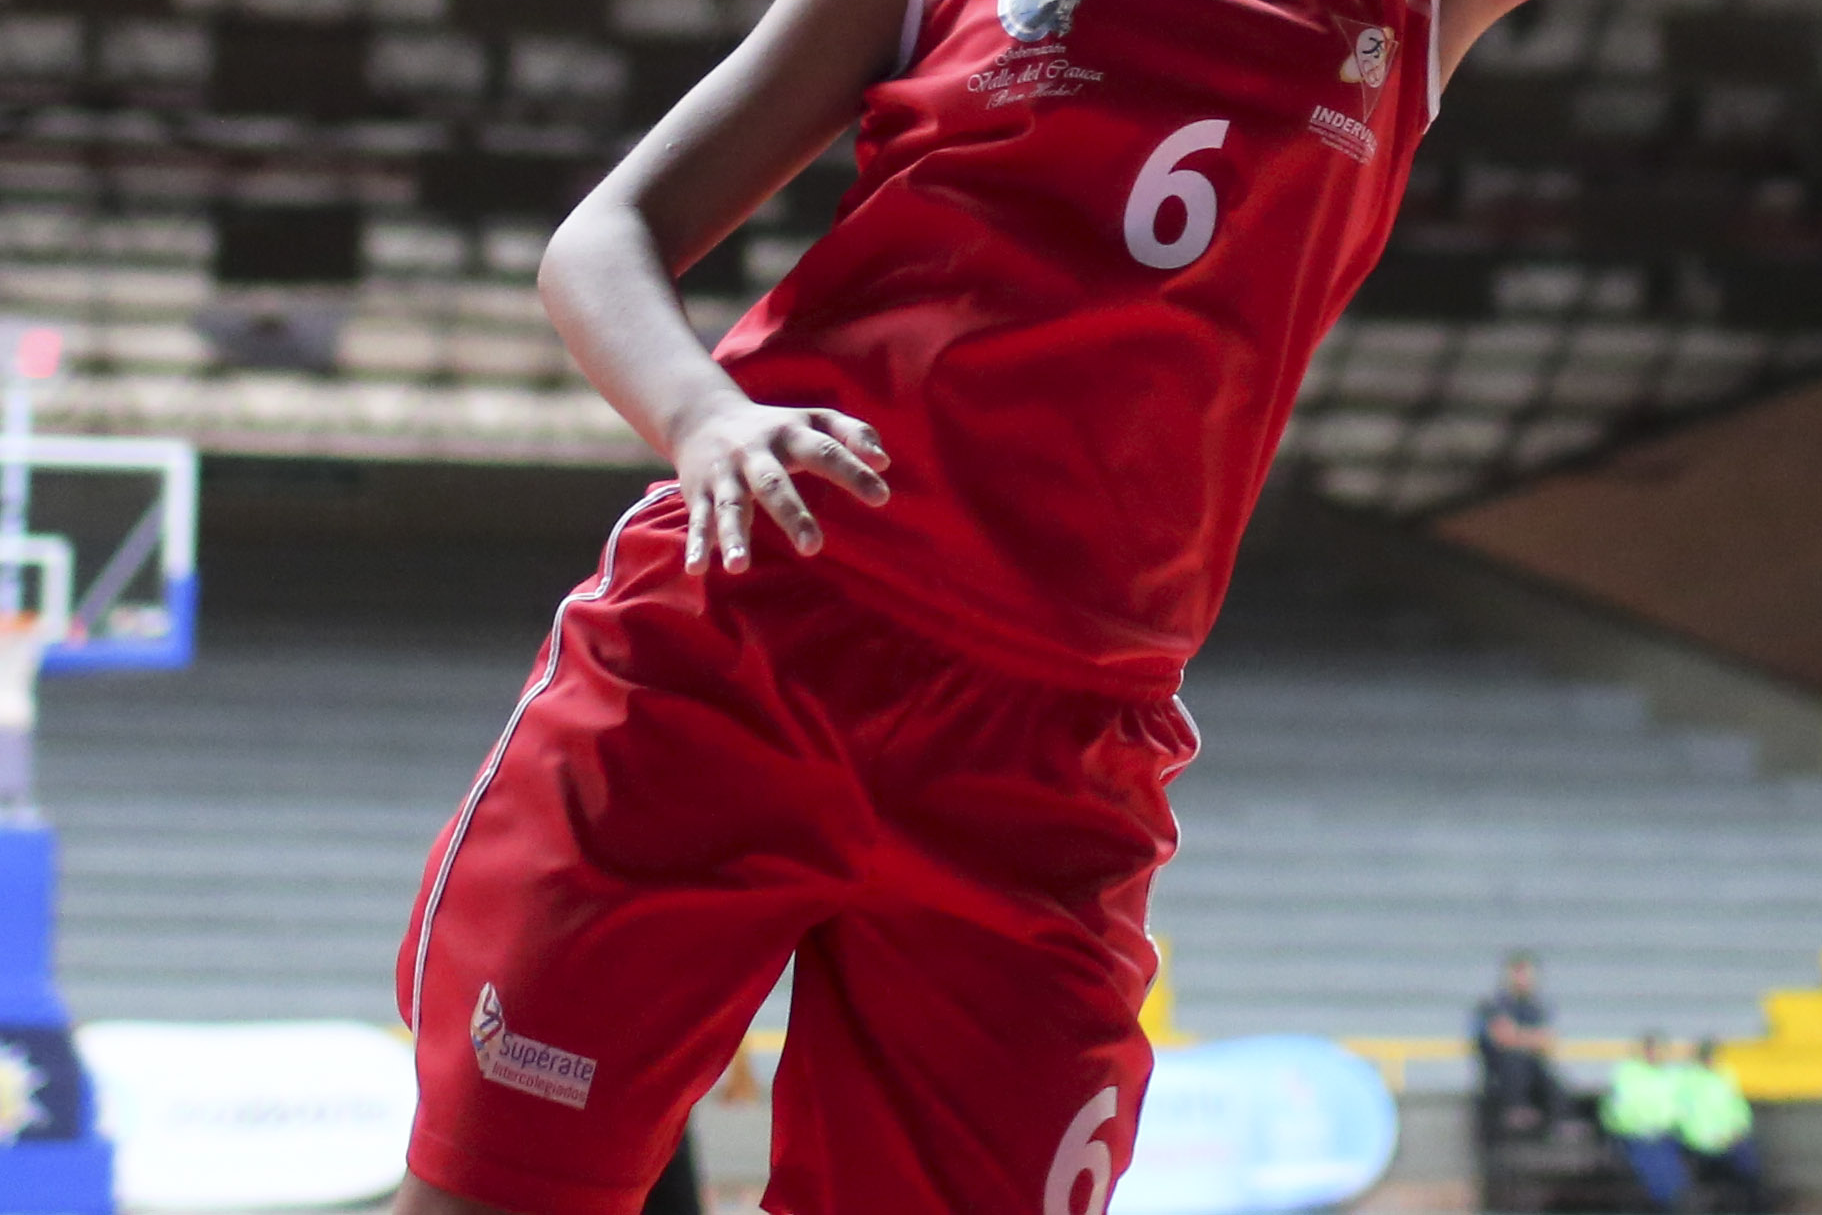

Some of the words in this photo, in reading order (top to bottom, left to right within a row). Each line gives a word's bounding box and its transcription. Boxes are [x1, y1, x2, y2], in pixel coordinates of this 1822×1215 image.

[967, 68, 1015, 93] Valle
[1017, 62, 1044, 84] del
[1046, 59, 1104, 81] Cauca
[1123, 118, 1231, 270] 6
[491, 1061, 588, 1103] Intercolegiados
[499, 1032, 595, 1082] Supérate
[1043, 1085, 1118, 1215] 6
